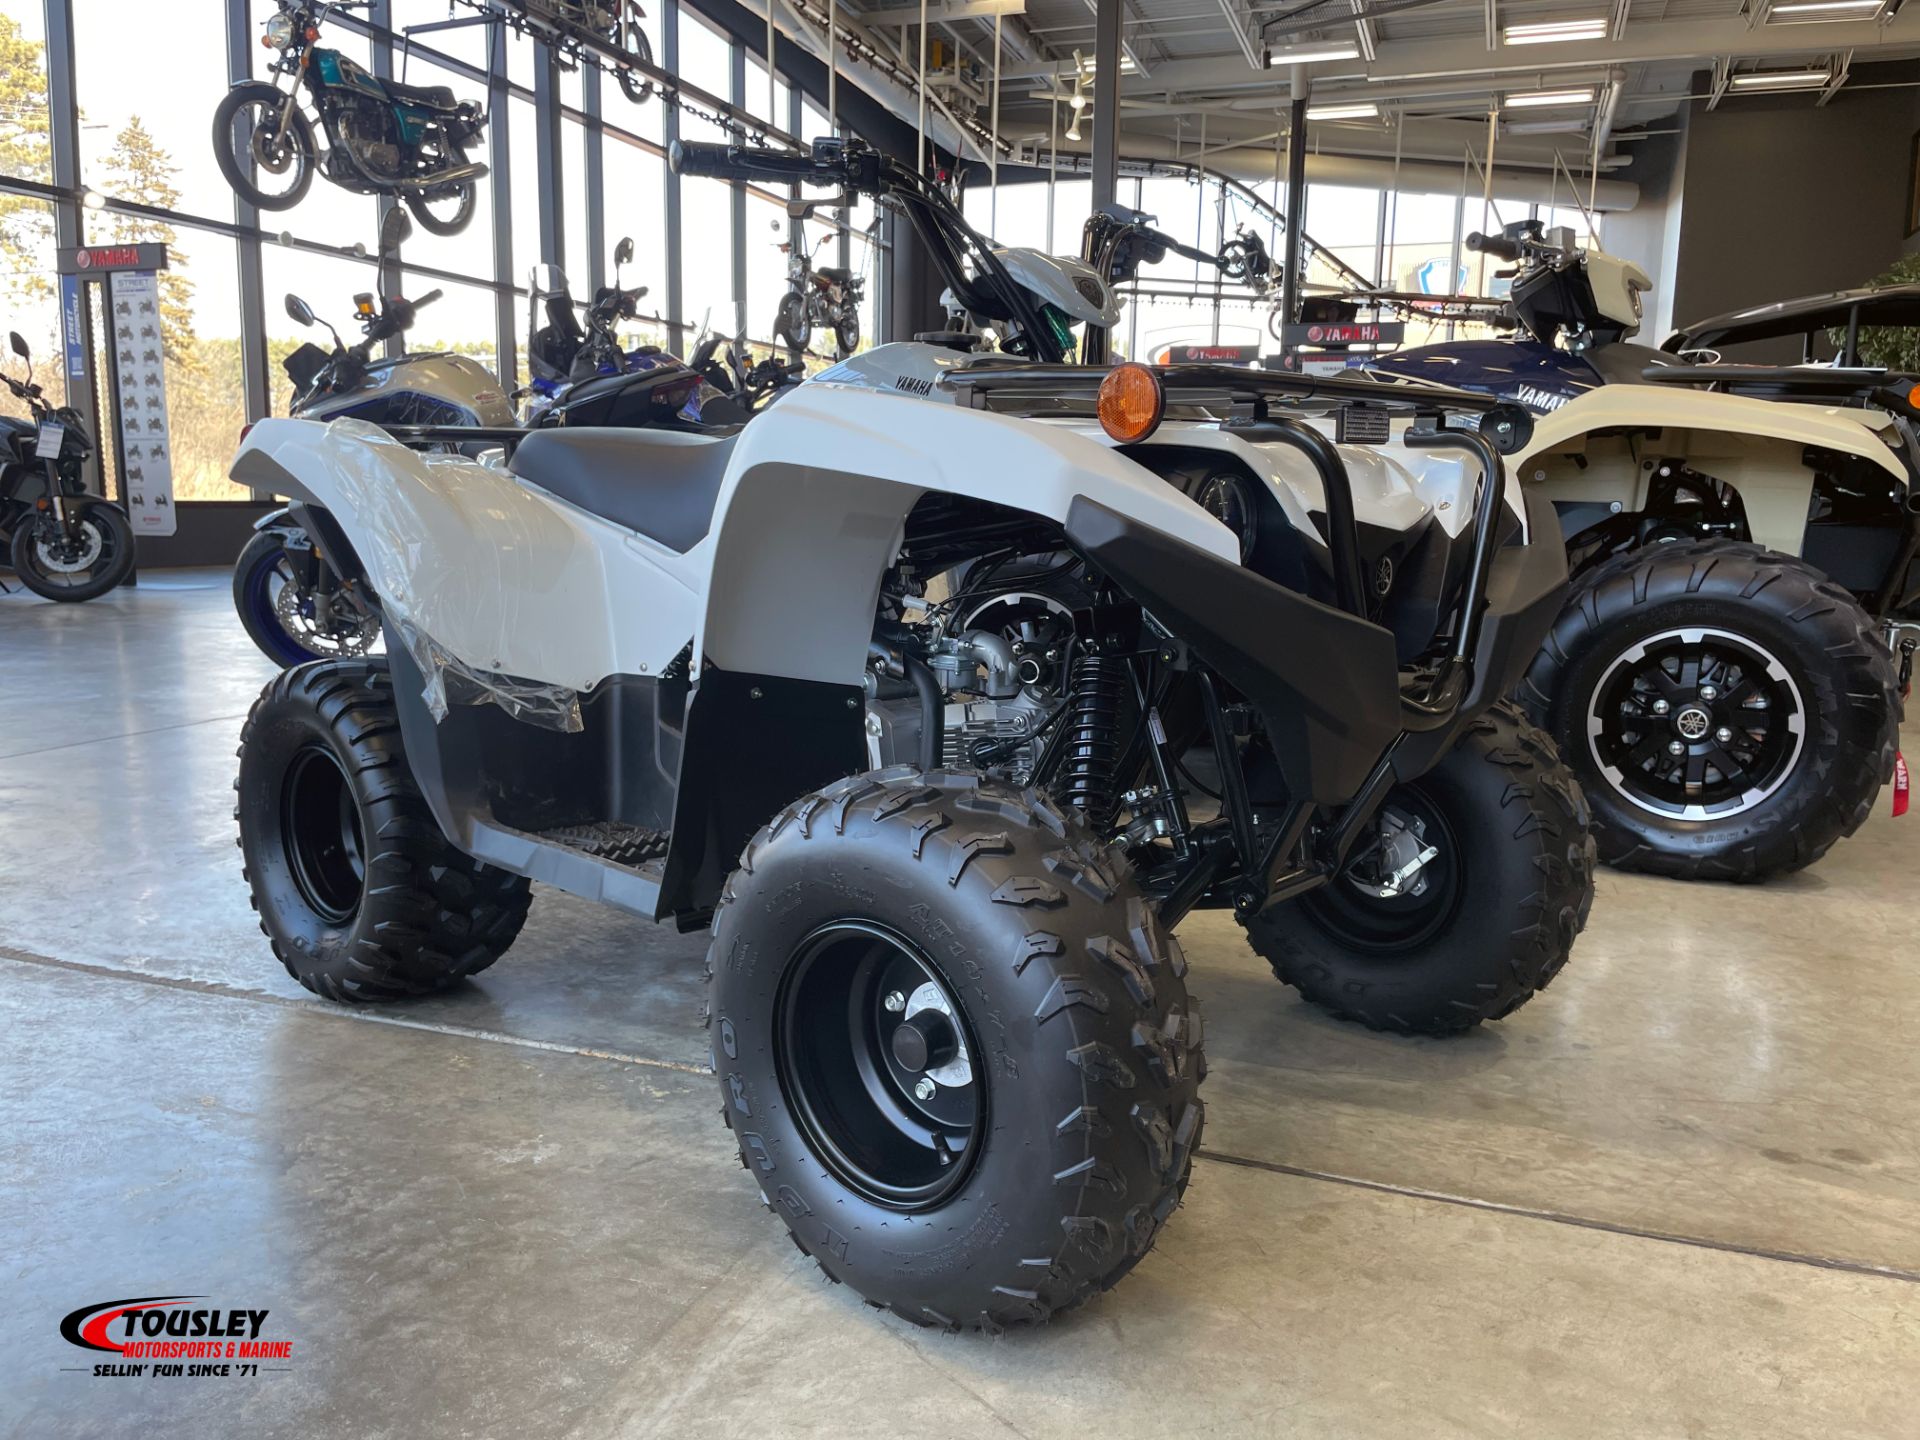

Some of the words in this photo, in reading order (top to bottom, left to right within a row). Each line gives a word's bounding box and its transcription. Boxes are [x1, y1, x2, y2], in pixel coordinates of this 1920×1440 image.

[91, 247, 140, 266] YAMAHA
[67, 308, 76, 346] STREET
[1323, 325, 1380, 341] YAMAHA
[895, 375, 934, 397] YAMAHA
[1895, 758, 1909, 791] WARN
[720, 1016, 813, 1219] DURO
